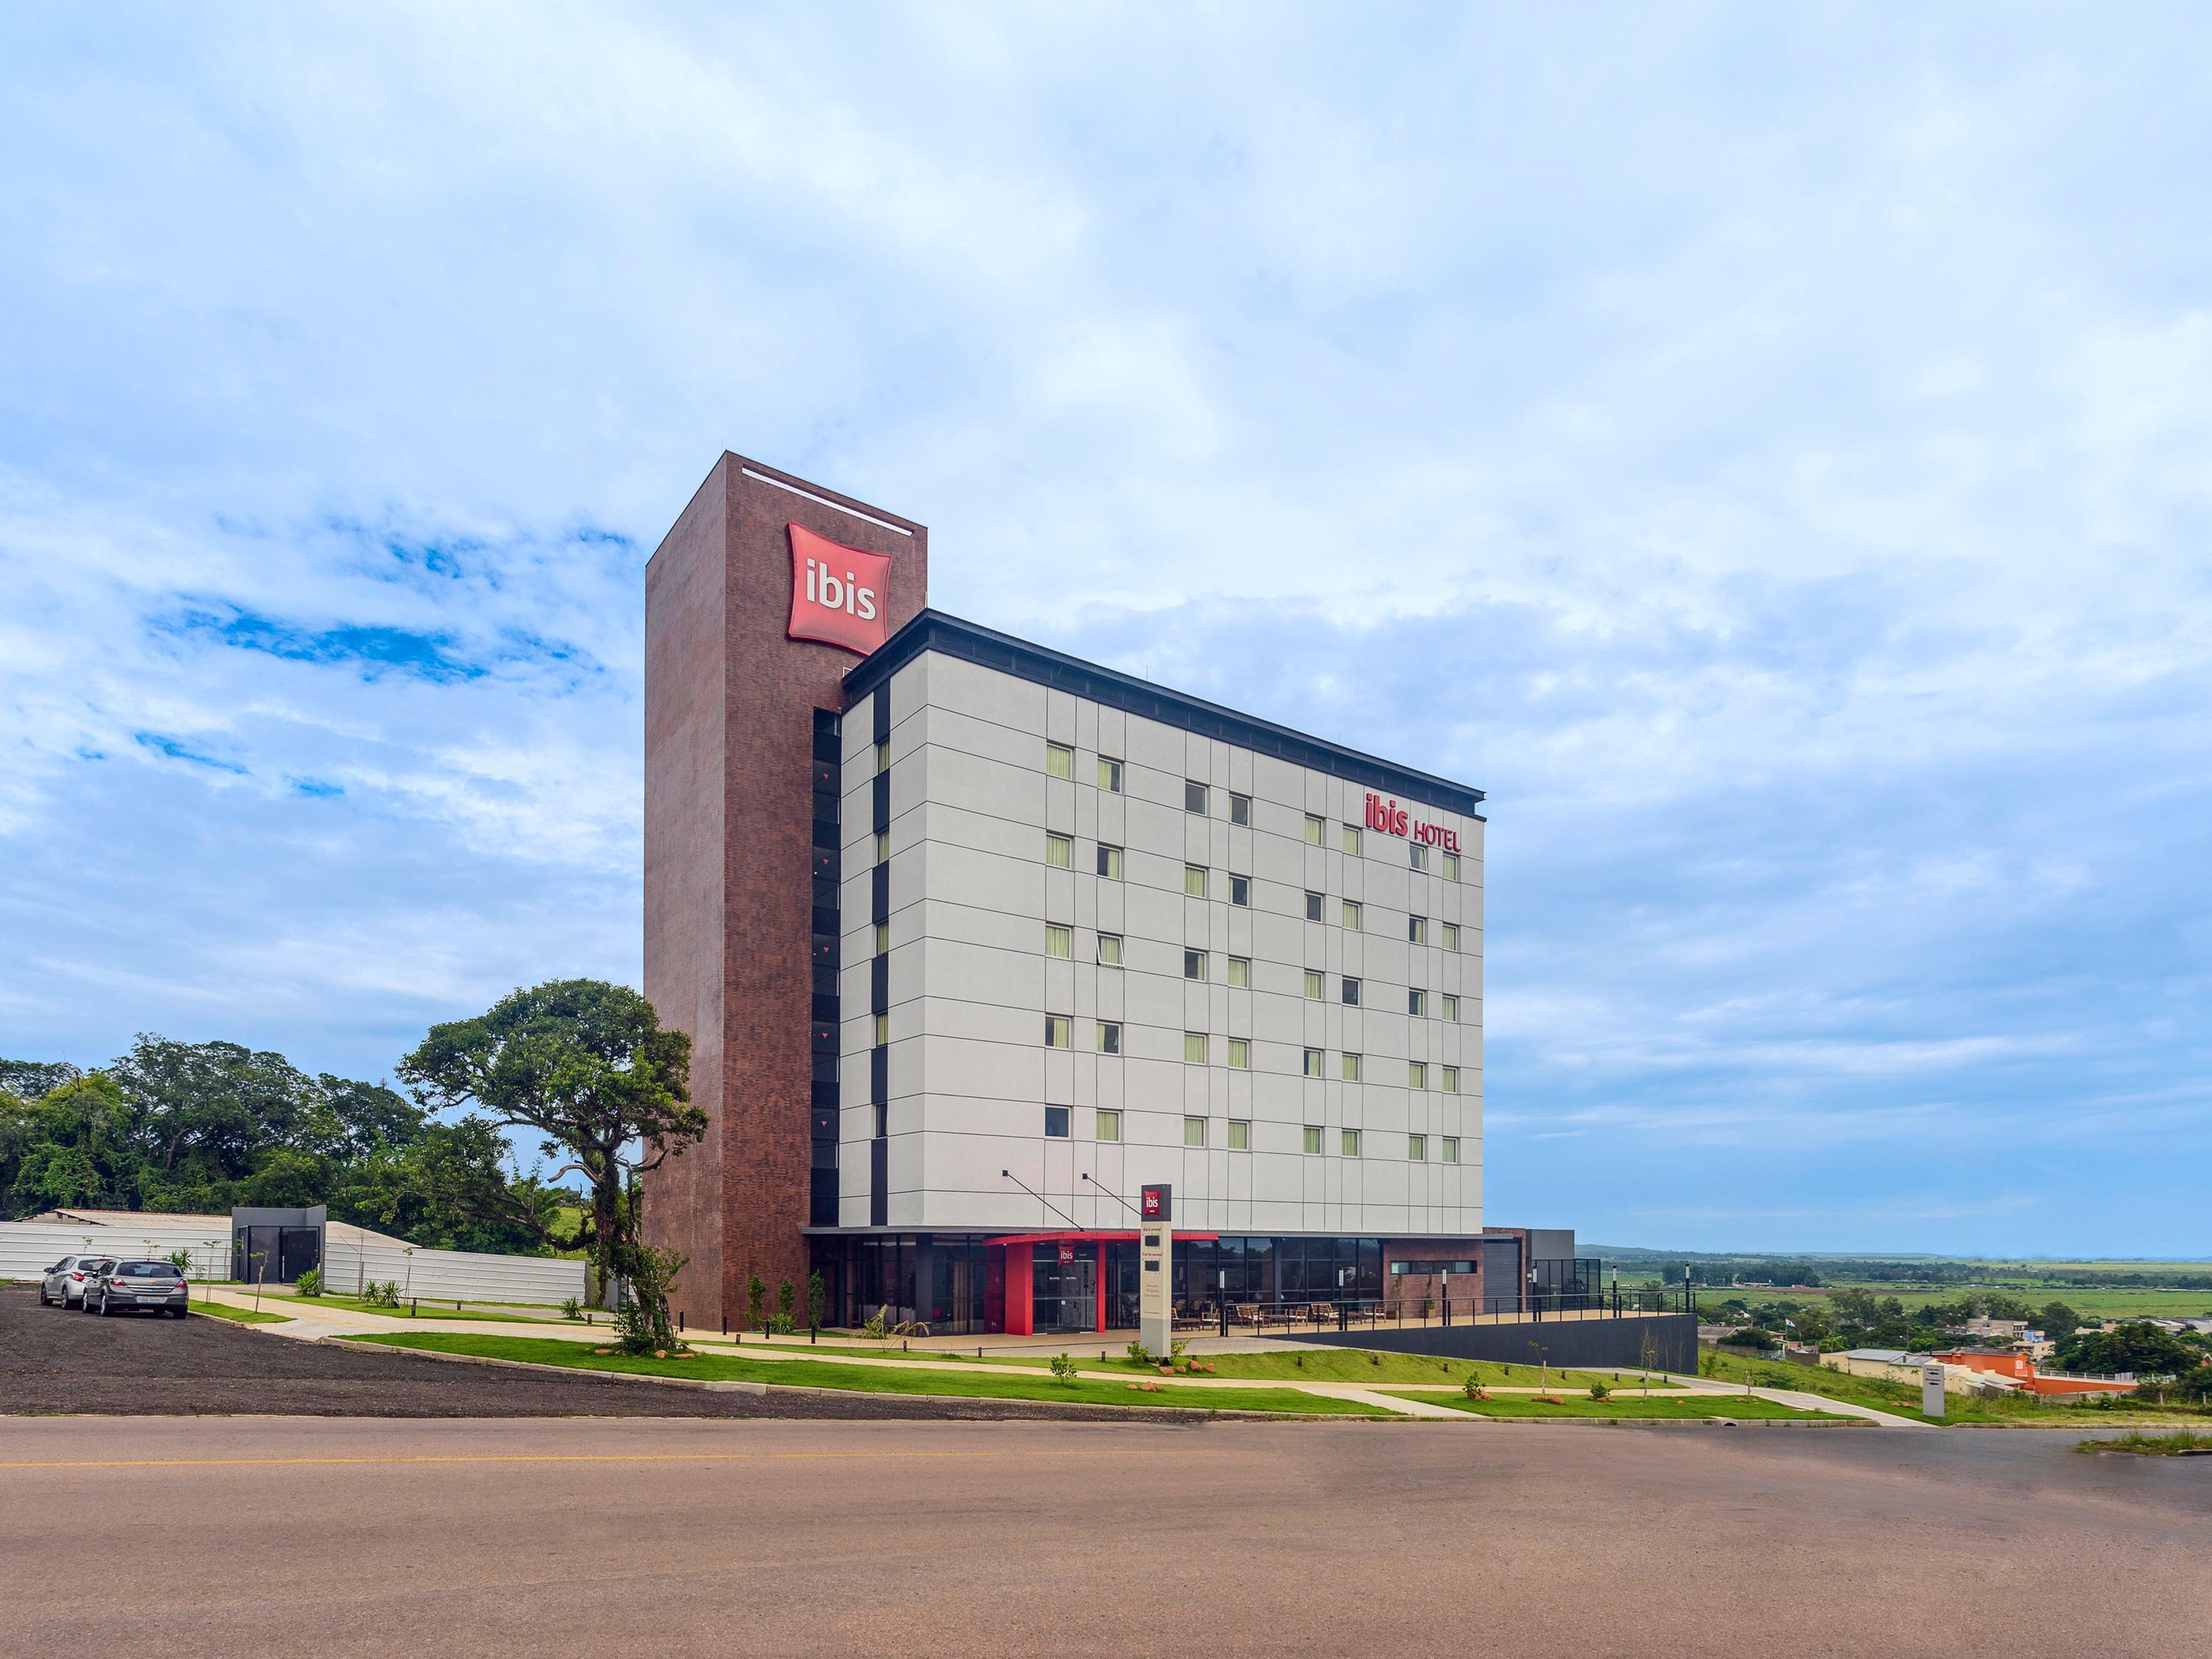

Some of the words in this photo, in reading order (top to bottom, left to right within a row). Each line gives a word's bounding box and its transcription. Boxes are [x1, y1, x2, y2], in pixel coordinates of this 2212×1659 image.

[807, 557, 876, 619] ibis
[1366, 793, 1408, 837] ibis
[1414, 820, 1461, 852] HOTEL
[1146, 1197, 1158, 1208] ibis
[1060, 1251, 1073, 1259] ibis
